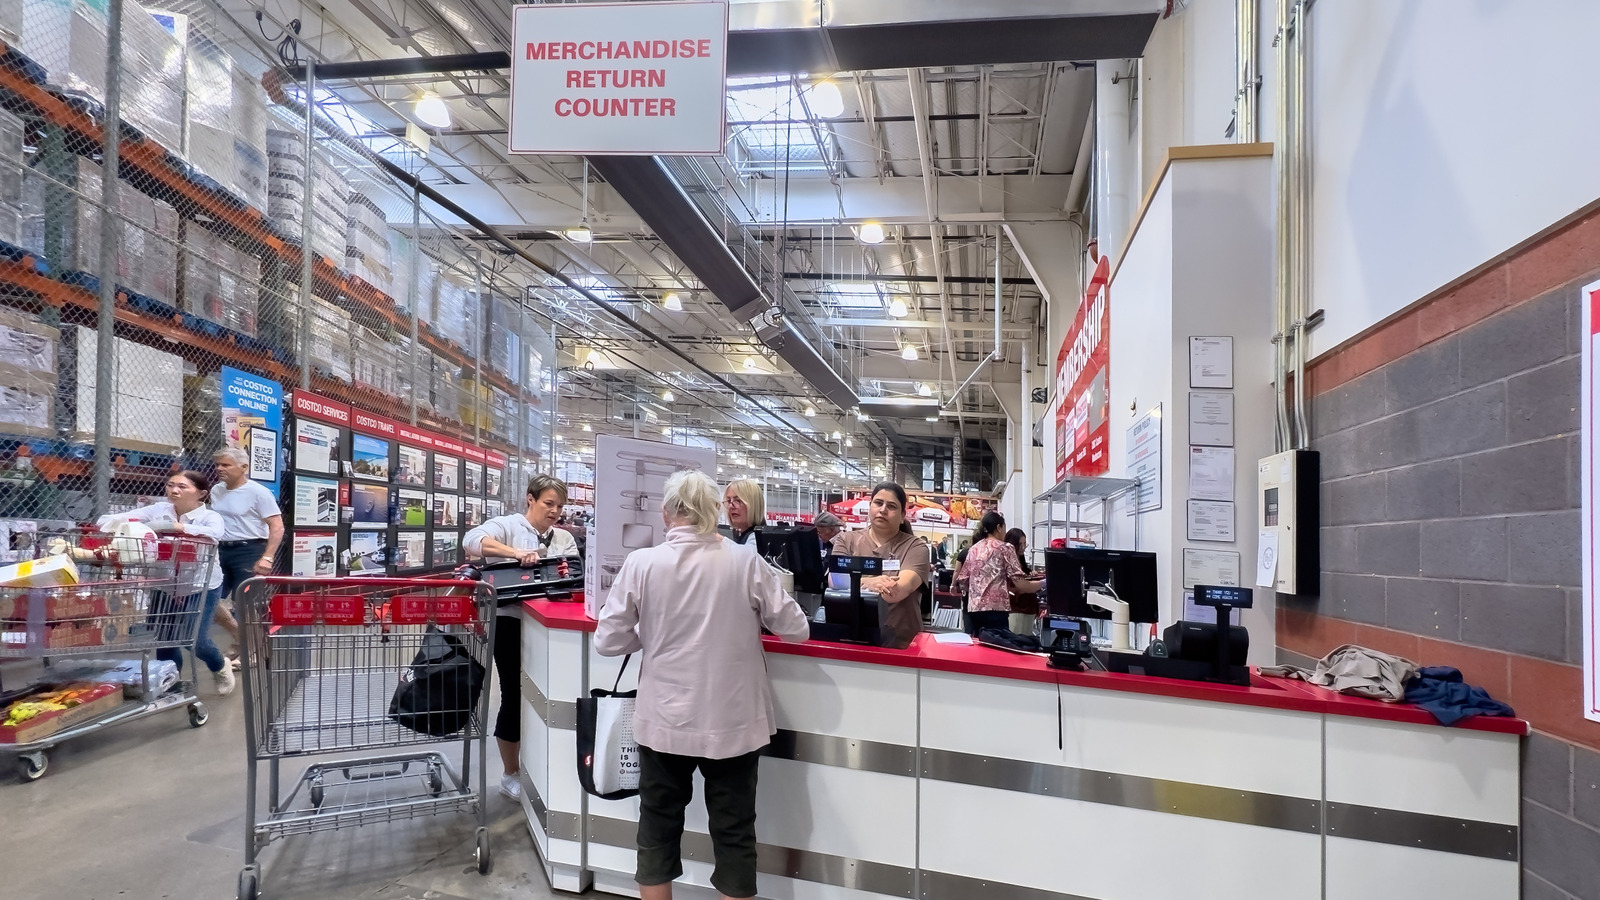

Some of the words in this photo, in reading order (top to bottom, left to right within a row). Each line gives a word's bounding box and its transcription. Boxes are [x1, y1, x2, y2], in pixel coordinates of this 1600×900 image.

[526, 39, 711, 60] MERCHANDISE
[566, 69, 666, 88] RETURN
[554, 98, 676, 117] COUNTER
[1056, 284, 1105, 412] MEMBERSHIP
[228, 385, 277, 405] CONNECTION
[243, 379, 273, 395] COSTCO
[238, 398, 269, 412] ONLINE!
[297, 398, 321, 414] COSTCO
[322, 405, 348, 421] SERVICES
[356, 415, 377, 428] COSTCO
[377, 420, 395, 434] TRAVEL
[775, 515, 805, 523] PHARMACY
